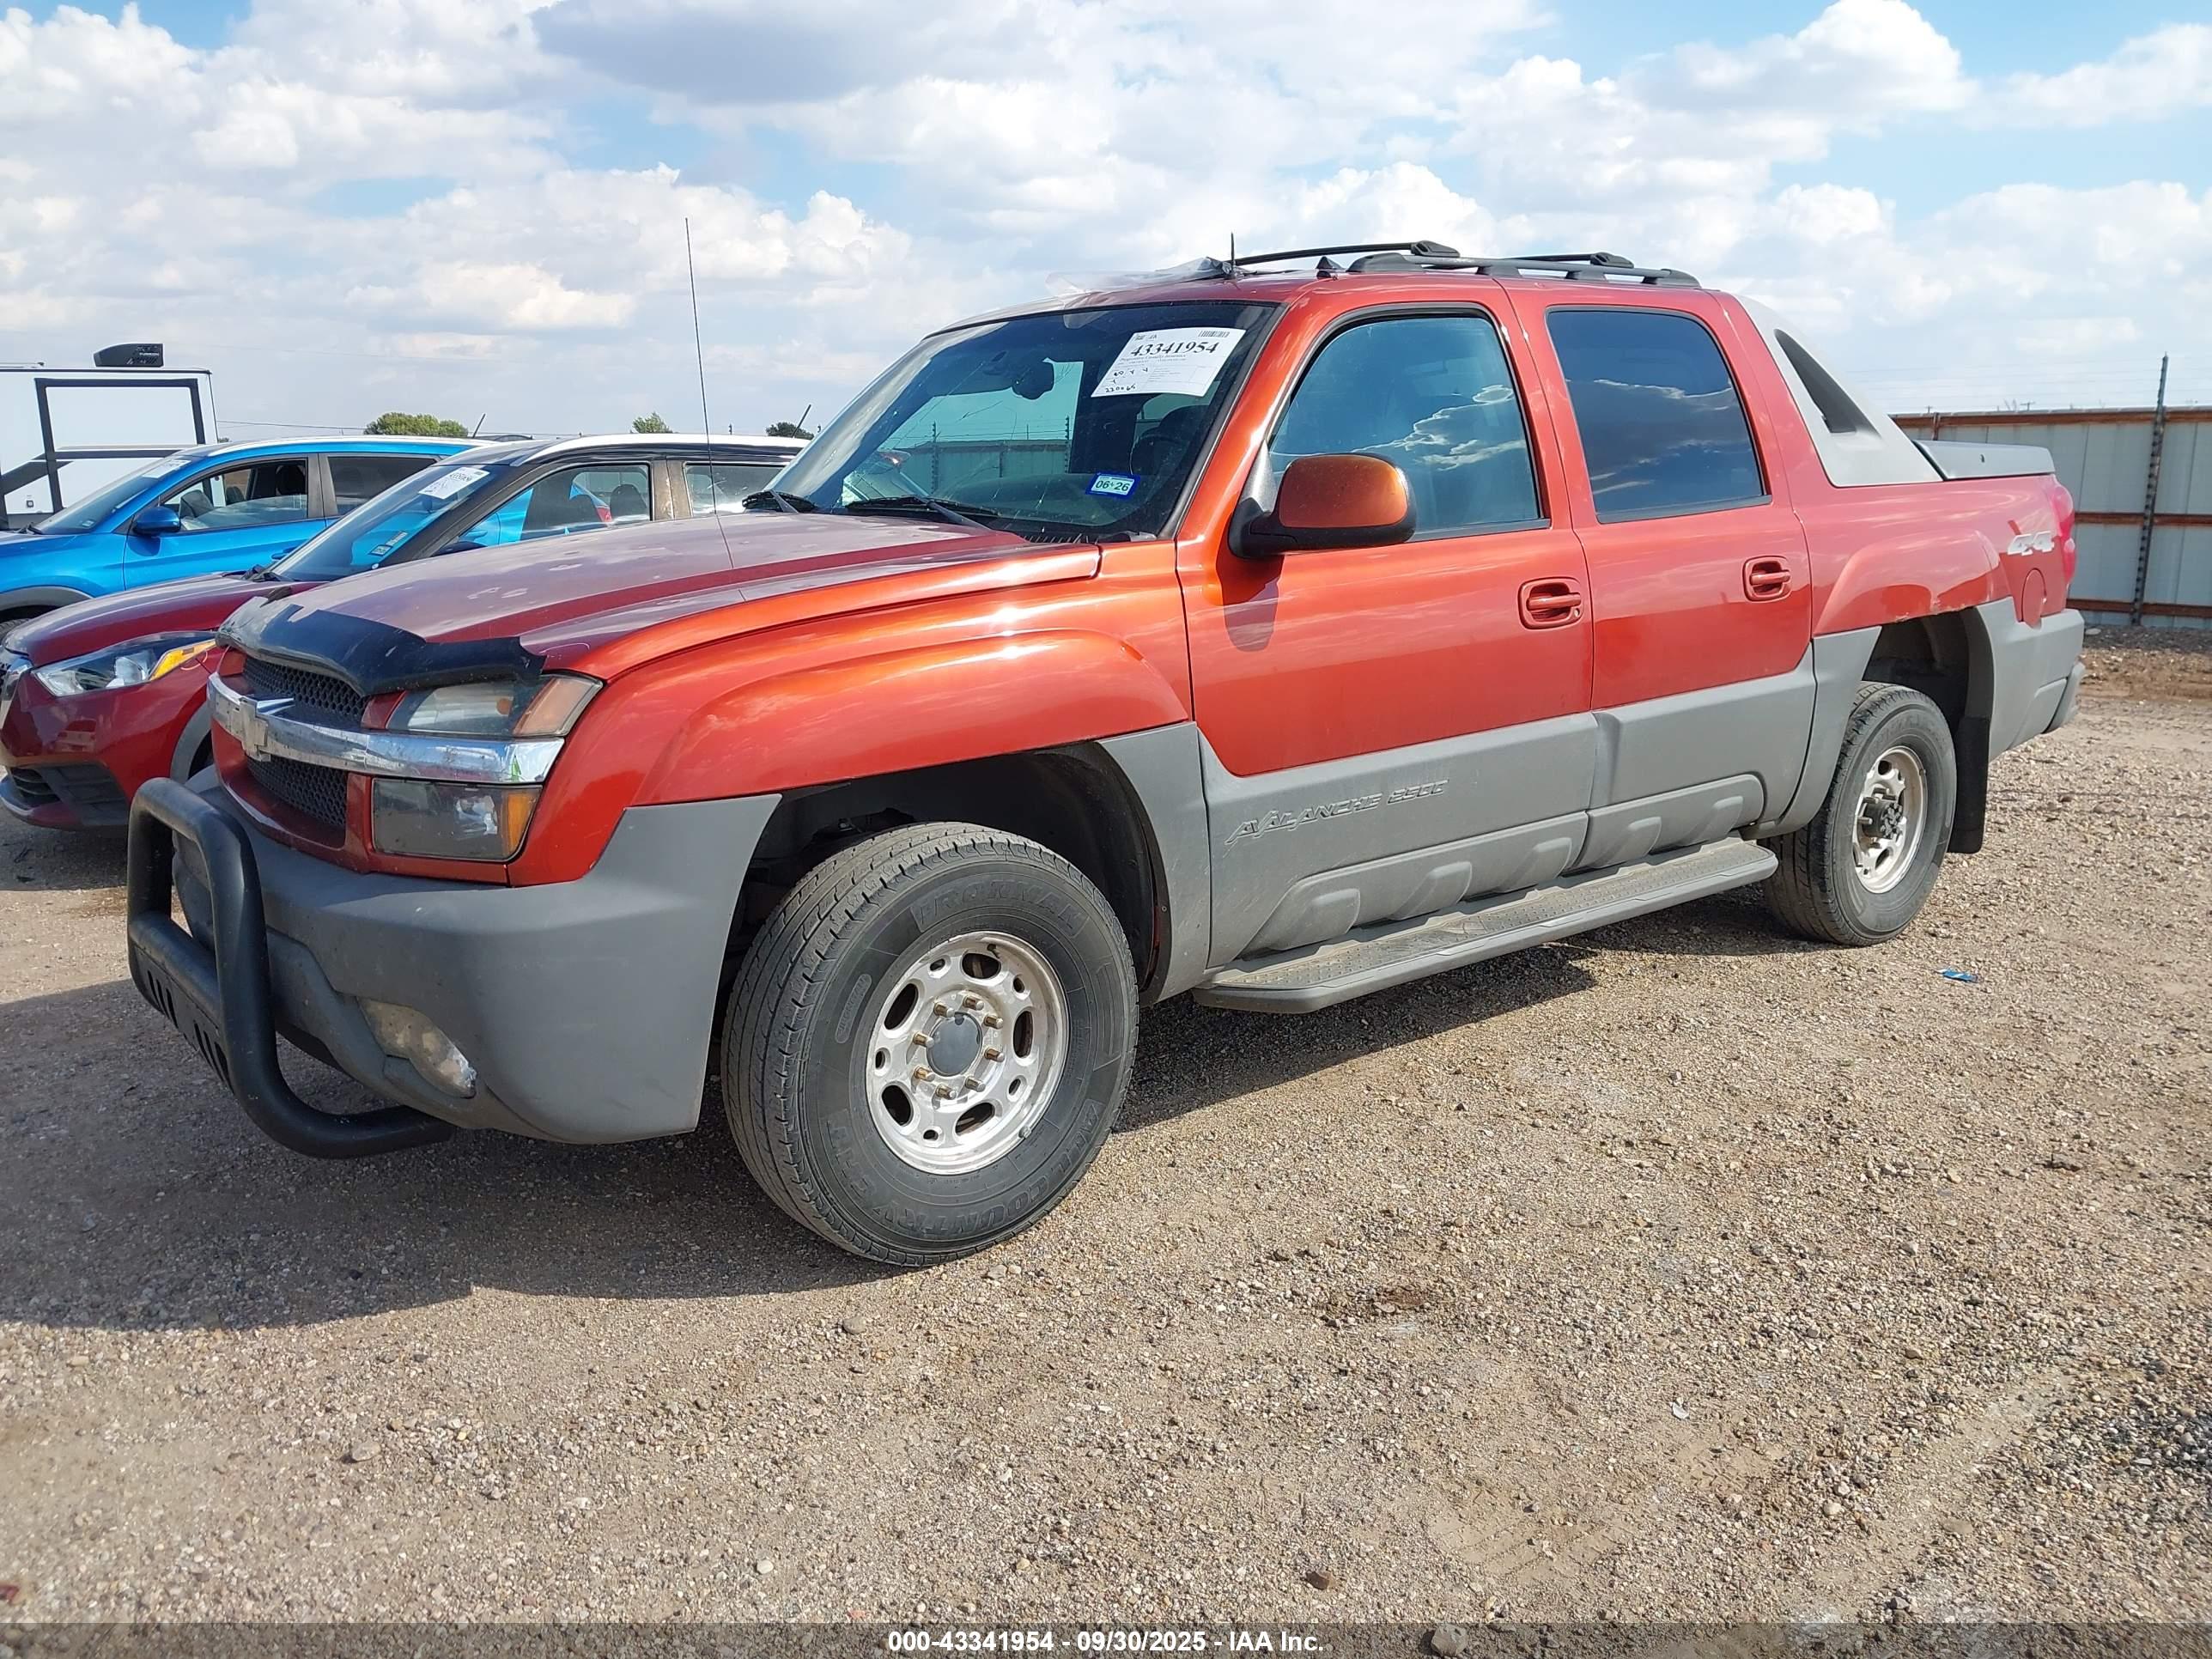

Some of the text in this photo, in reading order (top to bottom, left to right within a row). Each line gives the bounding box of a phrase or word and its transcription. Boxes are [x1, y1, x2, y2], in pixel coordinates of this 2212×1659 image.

[1130, 341, 1220, 356] 43341954
[1096, 480, 1130, 491] 06 26
[1224, 793, 1382, 845] AVALANCHE
[871, 1175, 1050, 1233] COUNTRY
